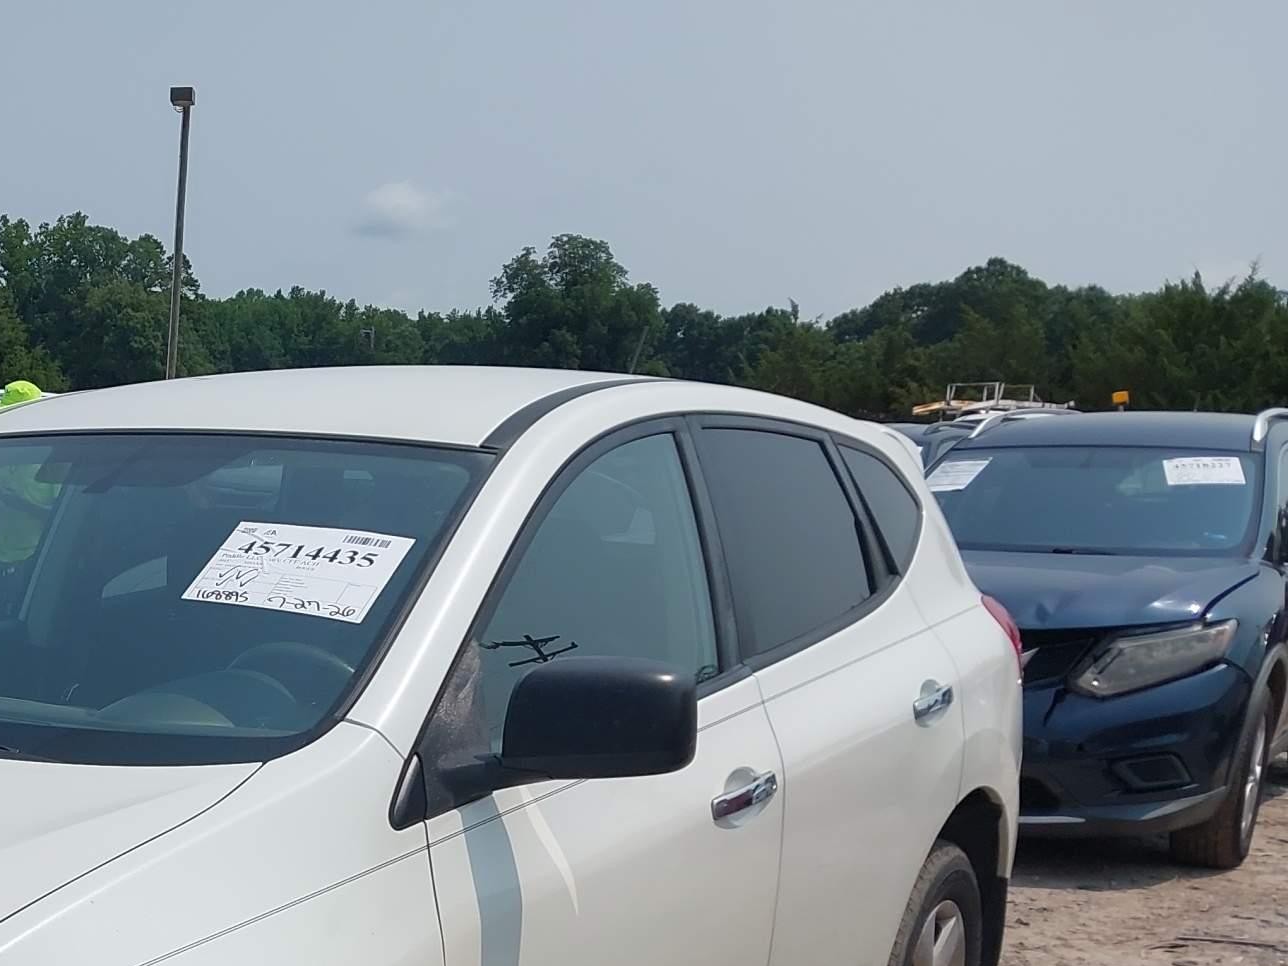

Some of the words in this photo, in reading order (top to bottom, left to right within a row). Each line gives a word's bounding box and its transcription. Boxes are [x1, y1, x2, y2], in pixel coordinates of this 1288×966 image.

[238, 540, 379, 568] 45714435
[196, 589, 249, 603] 168895
[267, 595, 356, 617] 7-27-26
